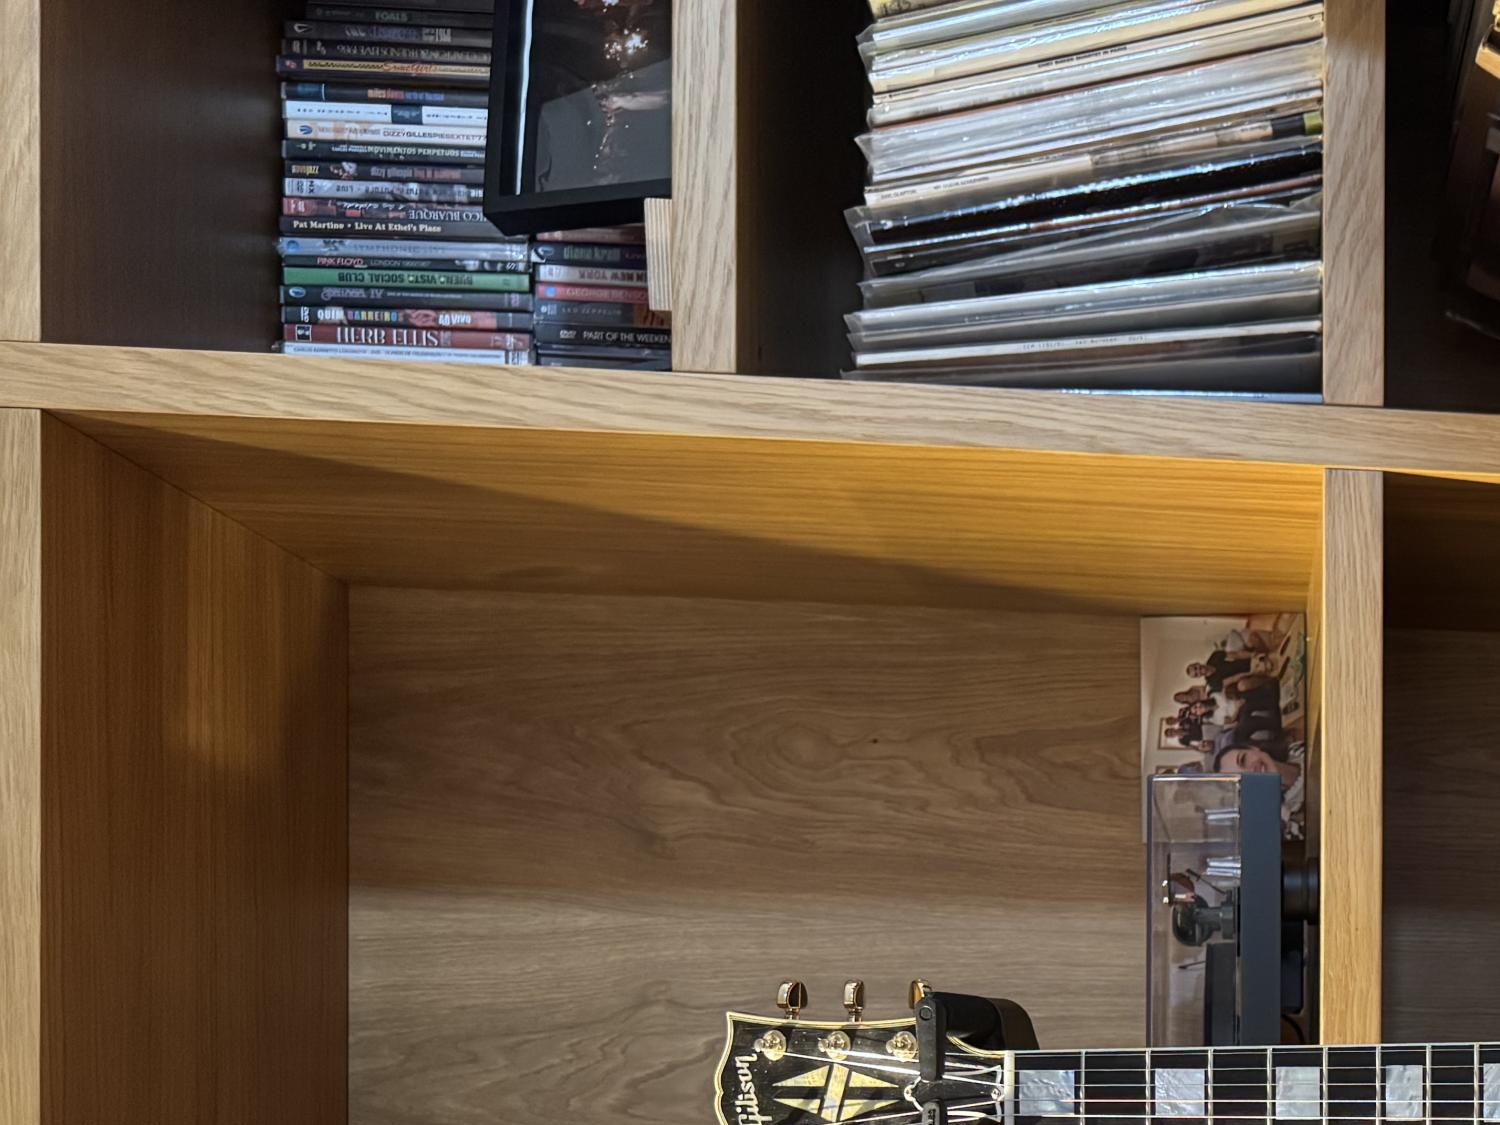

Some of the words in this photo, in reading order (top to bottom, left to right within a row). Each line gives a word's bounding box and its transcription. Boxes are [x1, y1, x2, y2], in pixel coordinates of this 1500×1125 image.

[409, 210, 460, 222] BUARQUE
[464, 212, 486, 222] ICO
[293, 221, 308, 229] Pat
[310, 221, 344, 230] Martino
[355, 222, 373, 231] Live
[375, 223, 386, 231] At
[388, 223, 416, 232] Ethel's
[419, 224, 441, 232] Place
[317, 257, 335, 265] PINK
[337, 258, 363, 266] FLOYD
[338, 272, 364, 282] CLUB
[368, 273, 404, 283] SOCIAL
[336, 327, 385, 344] HERB
[392, 328, 439, 346] ELLIS
[606, 332, 619, 340] OF
